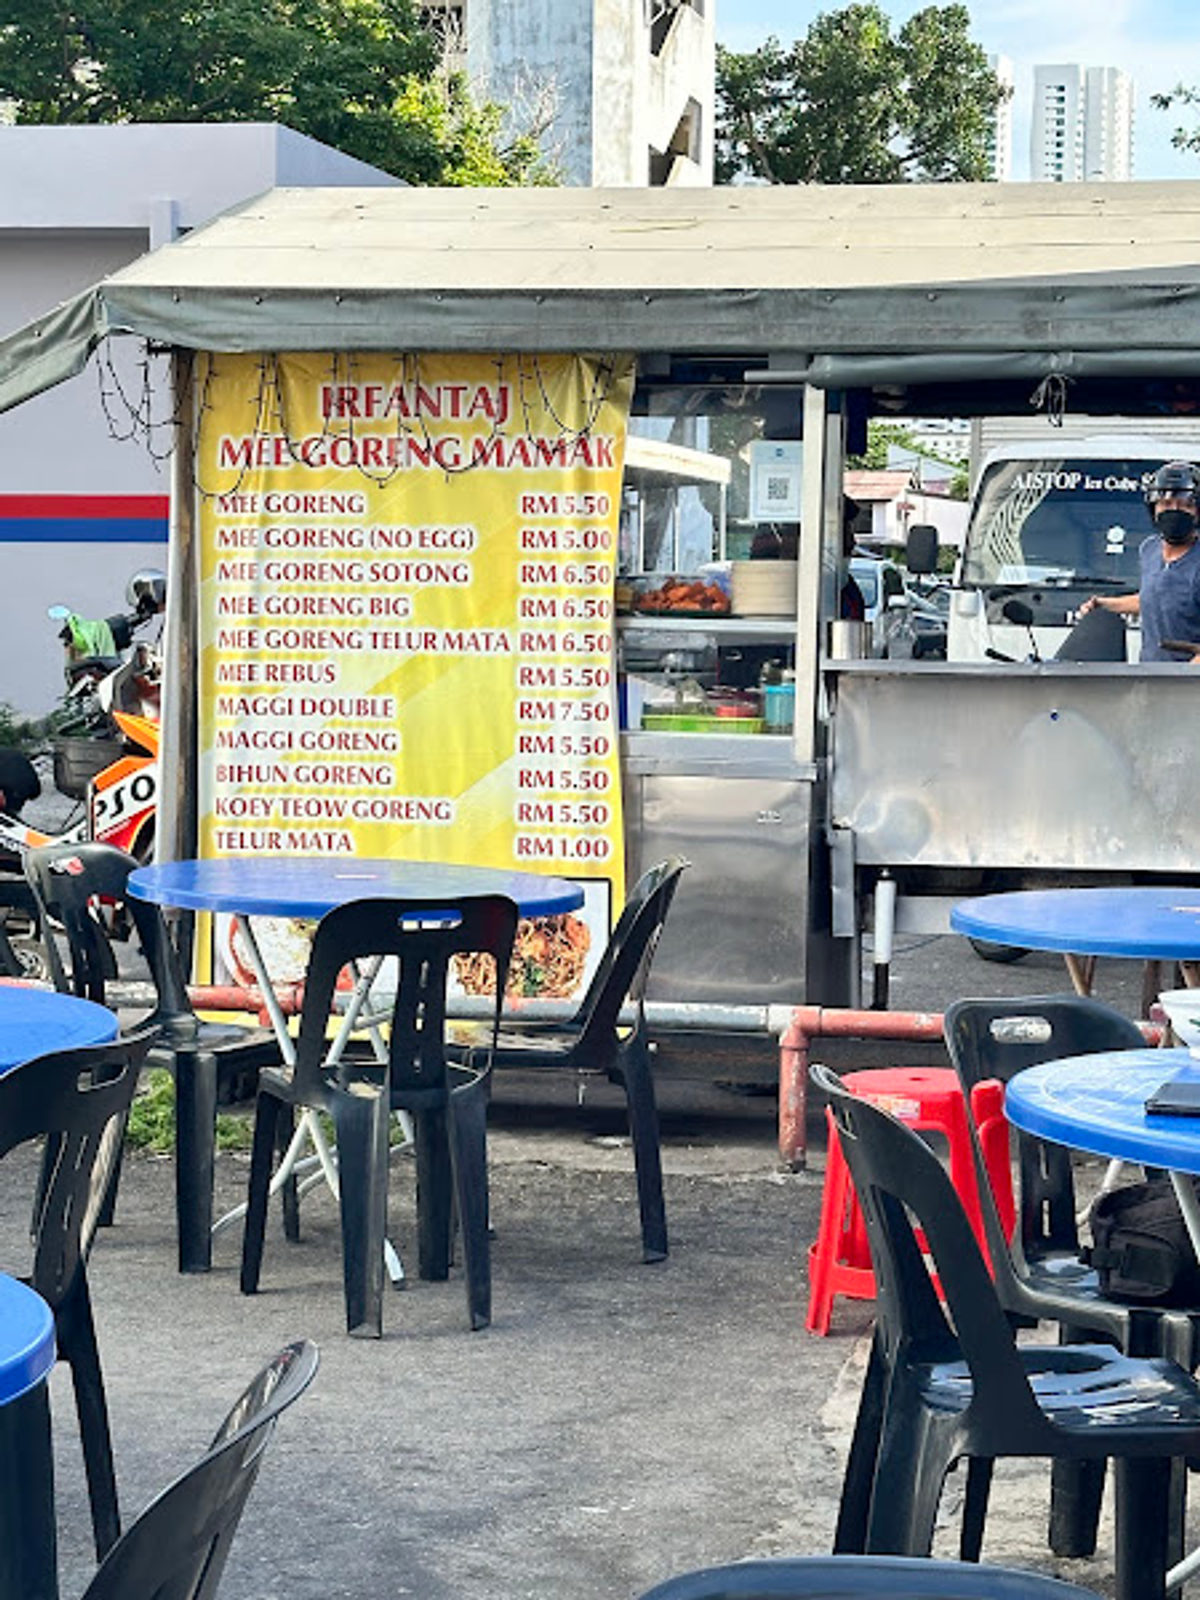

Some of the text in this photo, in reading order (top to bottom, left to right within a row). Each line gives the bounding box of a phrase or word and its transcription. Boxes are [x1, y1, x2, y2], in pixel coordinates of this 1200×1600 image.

[321, 385, 509, 424] IRFANTAJ
[220, 437, 615, 467] MEE GORENG MAMAK
[217, 494, 365, 513] MEE GORENG
[521, 495, 610, 514] RM 5.50
[217, 528, 474, 550] MEE GORENG (NO EGG)
[521, 530, 612, 550] RM 5.00
[217, 562, 469, 582] MEE GORENG SOTONG
[521, 564, 612, 583] RM 6.50
[217, 596, 410, 617] MEE GORENG BIG
[520, 599, 611, 618] RM 6.50
[217, 630, 510, 651] MEE GORENG TELUR MATA
[520, 633, 611, 653] RM 6.50
[217, 664, 336, 683] MEE REBUS
[519, 668, 611, 687] RM 5.50
[217, 697, 393, 718] MAGGI DOUBLE
[519, 701, 610, 721] RM 7.50
[216, 731, 398, 752] MAGGI GORENG
[519, 735, 610, 755] RM 5.50
[216, 765, 392, 786] BIHUN GORENG
[519, 769, 609, 790] RM 5.50
[215, 797, 452, 820] KOEY TEOW GORENG
[518, 803, 608, 824] RM 5.50
[215, 831, 353, 852] TELUR MATA
[518, 837, 609, 857] RM 1.00
